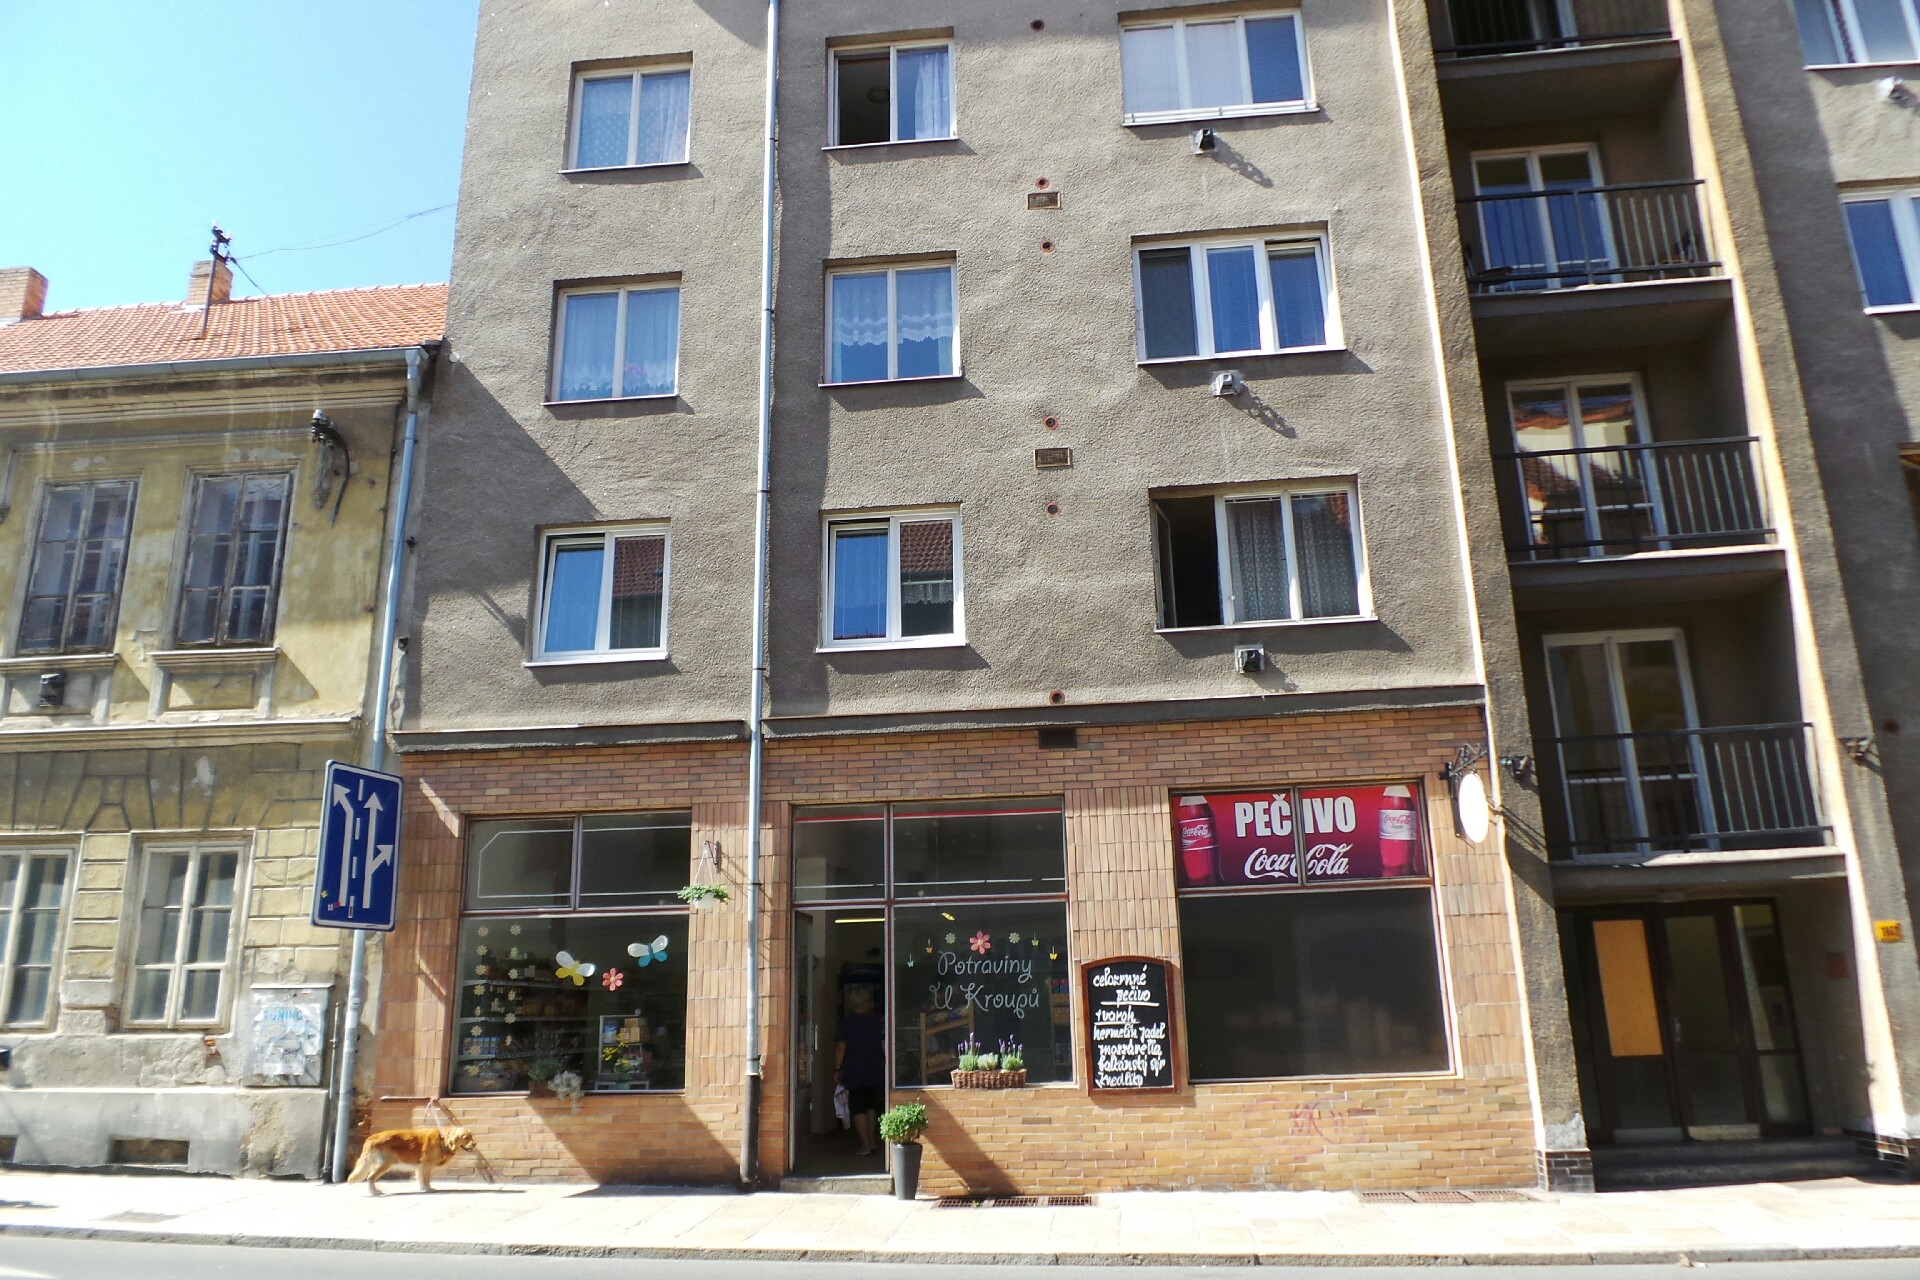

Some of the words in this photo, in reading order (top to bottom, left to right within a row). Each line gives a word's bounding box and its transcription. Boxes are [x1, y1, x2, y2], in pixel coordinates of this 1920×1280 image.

[1244, 843, 1354, 879] Coca-Cola
[937, 950, 1033, 984] Potraviny
[929, 981, 954, 1010] U
[960, 982, 1040, 1019] Kroupů
[1115, 986, 1151, 1008] pečivo
